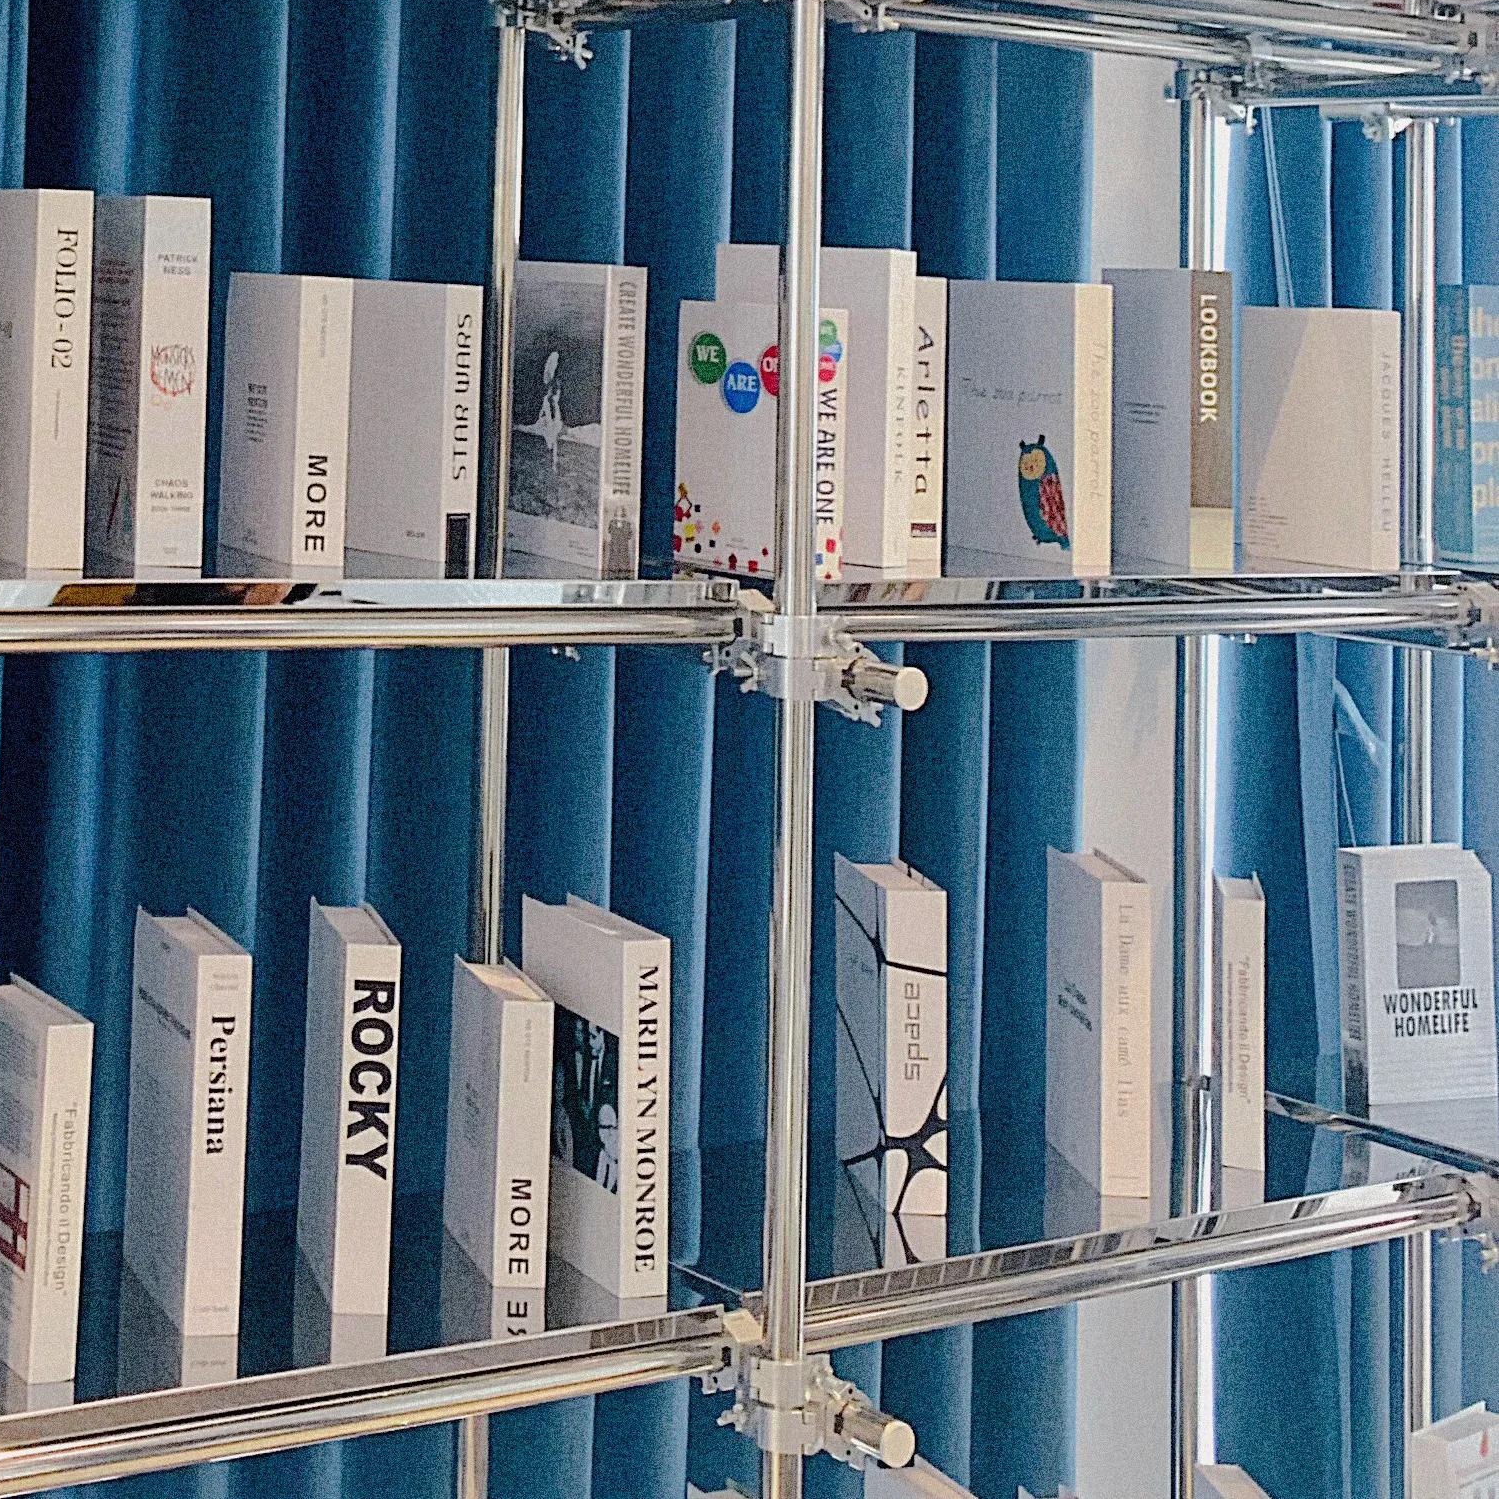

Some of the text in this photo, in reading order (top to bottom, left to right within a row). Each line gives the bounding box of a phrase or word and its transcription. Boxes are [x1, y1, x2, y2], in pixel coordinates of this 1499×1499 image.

[452, 312, 473, 481] STAR WARS
[612, 281, 638, 496] CREATE WONDERFUL HOMELIFE
[696, 345, 720, 364] WE
[727, 374, 757, 393] ARE
[915, 326, 936, 494] Arletta
[1198, 294, 1218, 423] LOOKBOOK
[304, 454, 329, 554] MORE
[816, 388, 839, 525] WE ARE ONE
[904, 982, 934, 1082] space
[1383, 987, 1479, 1014] WONDERFUL
[1394, 1012, 1472, 1039] HOMELIFE
[205, 1015, 237, 1156] Persiana
[345, 978, 396, 1181] ROCKY
[634, 965, 659, 1272] MARILYN MONROE
[509, 1178, 532, 1276] MORE
